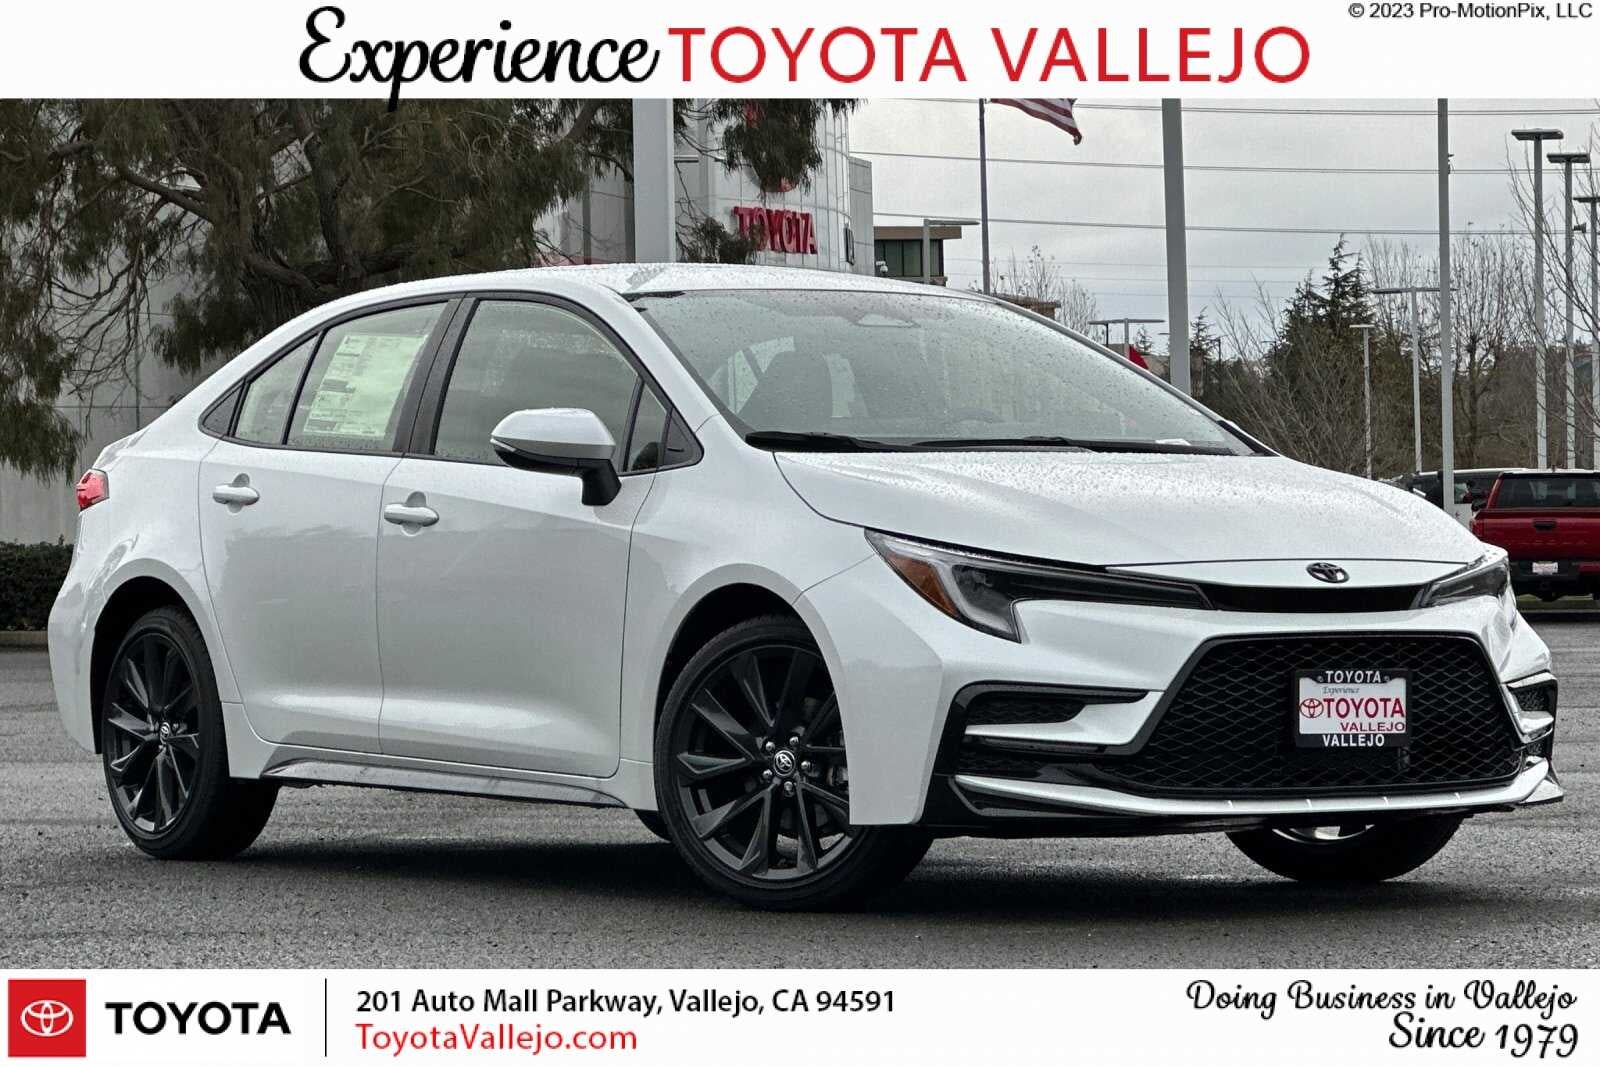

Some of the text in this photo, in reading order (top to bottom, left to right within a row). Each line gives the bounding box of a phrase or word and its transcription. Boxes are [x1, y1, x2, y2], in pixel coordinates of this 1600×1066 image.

[1326, 671, 1381, 683] TOYOTA
[1323, 698, 1405, 718] TOYOTA
[1340, 722, 1406, 732] VALLEJO
[1323, 734, 1385, 747] VALLEJO
